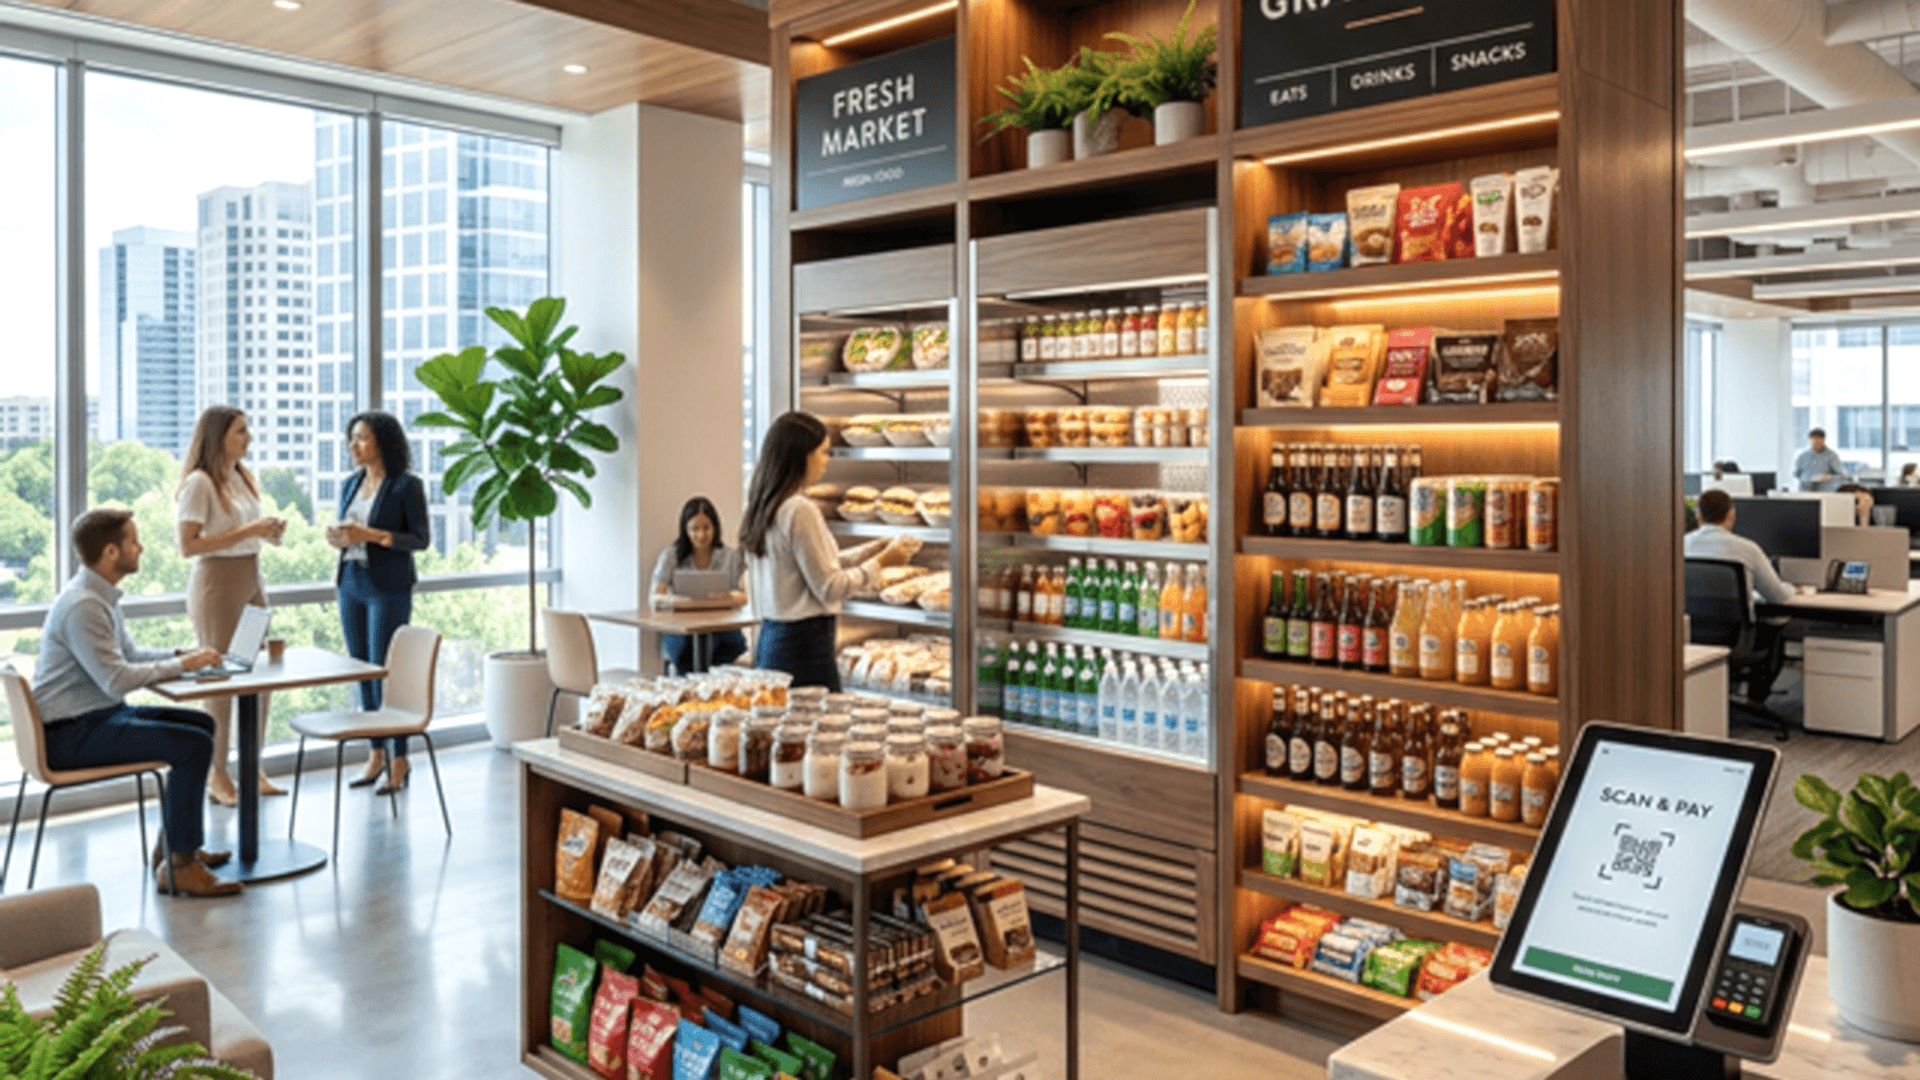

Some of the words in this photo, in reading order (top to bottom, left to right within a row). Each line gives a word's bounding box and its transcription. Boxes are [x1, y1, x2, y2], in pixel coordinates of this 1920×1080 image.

[833, 74, 915, 119] FRESH
[1269, 84, 1308, 107] EATS
[1350, 63, 1416, 91] DRINKS
[1451, 41, 1527, 72] SNACKS
[821, 108, 927, 157] MARKET
[1600, 787, 1653, 808] SCAN
[1656, 797, 1669, 812] &
[1675, 799, 1714, 819] PAY
